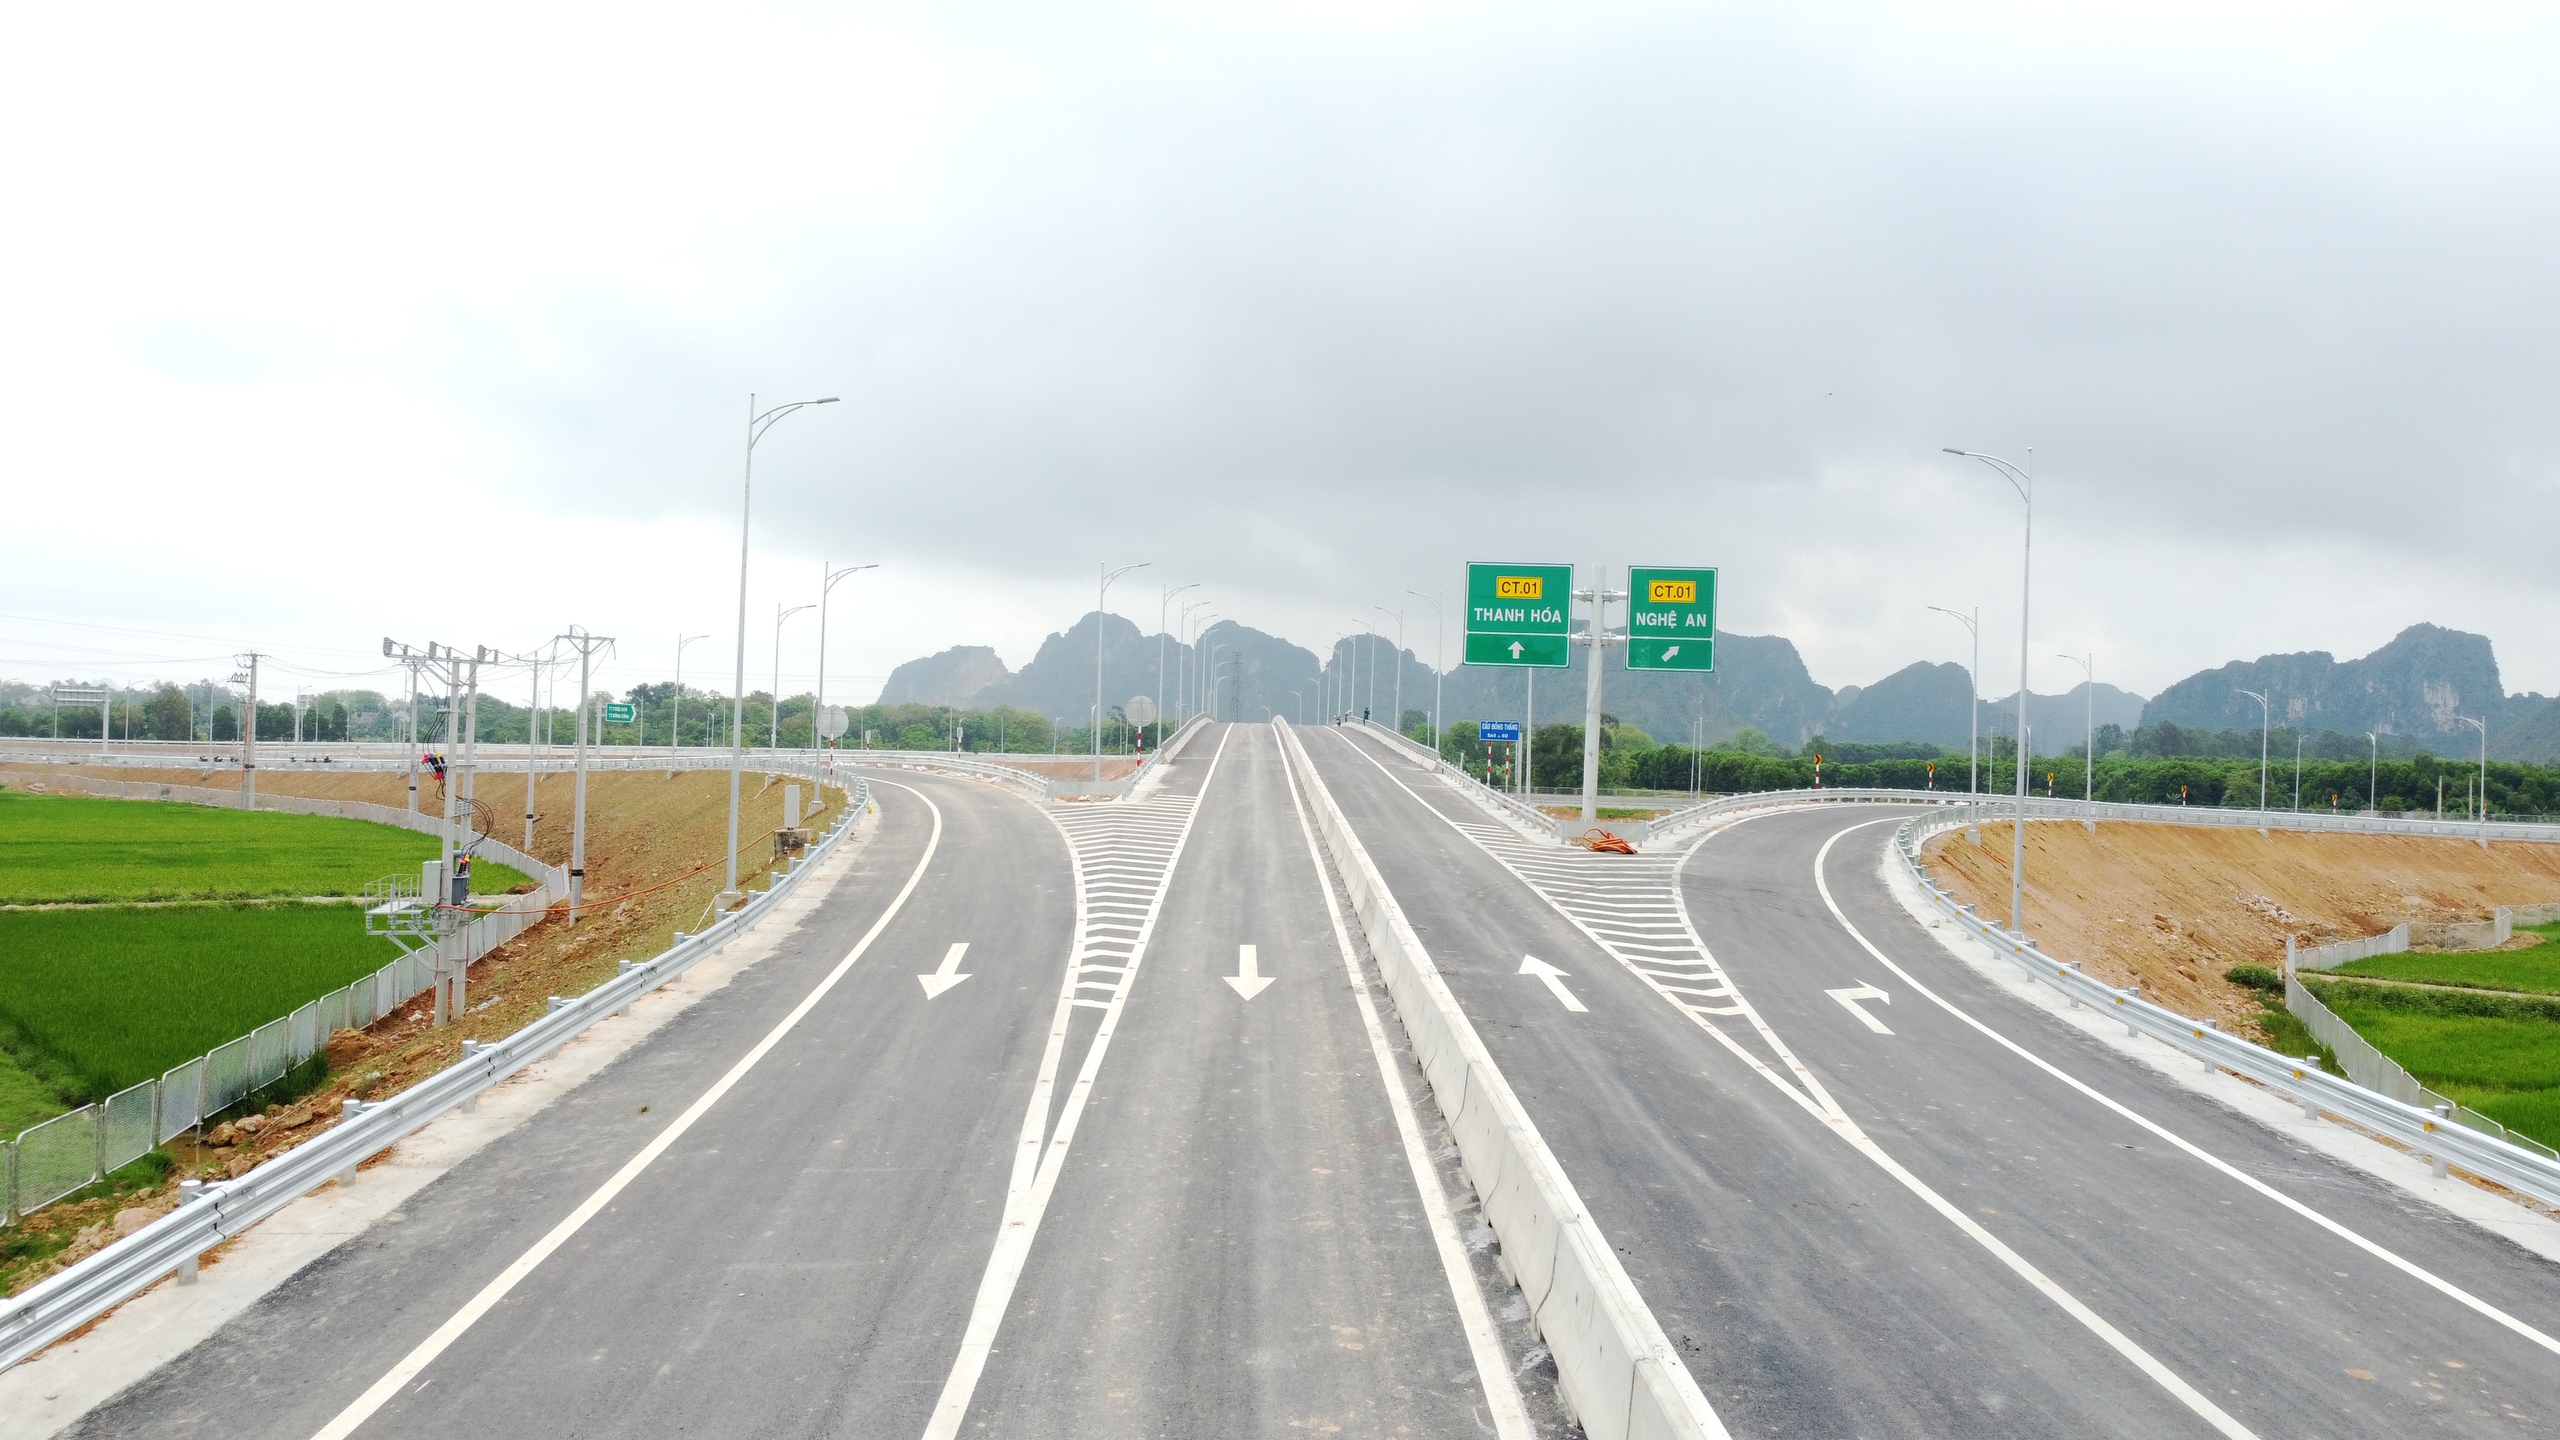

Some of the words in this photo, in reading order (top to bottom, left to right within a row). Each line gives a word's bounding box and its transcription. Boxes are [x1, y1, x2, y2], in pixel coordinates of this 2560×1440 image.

[1501, 581, 1537, 594] CT.01
[1654, 585, 1691, 598] CT.01
[1474, 607, 1525, 622] THANH
[1530, 606, 1562, 623] HÓA
[1636, 610, 1677, 629] NGHỆ
[1685, 613, 1707, 627] AN
